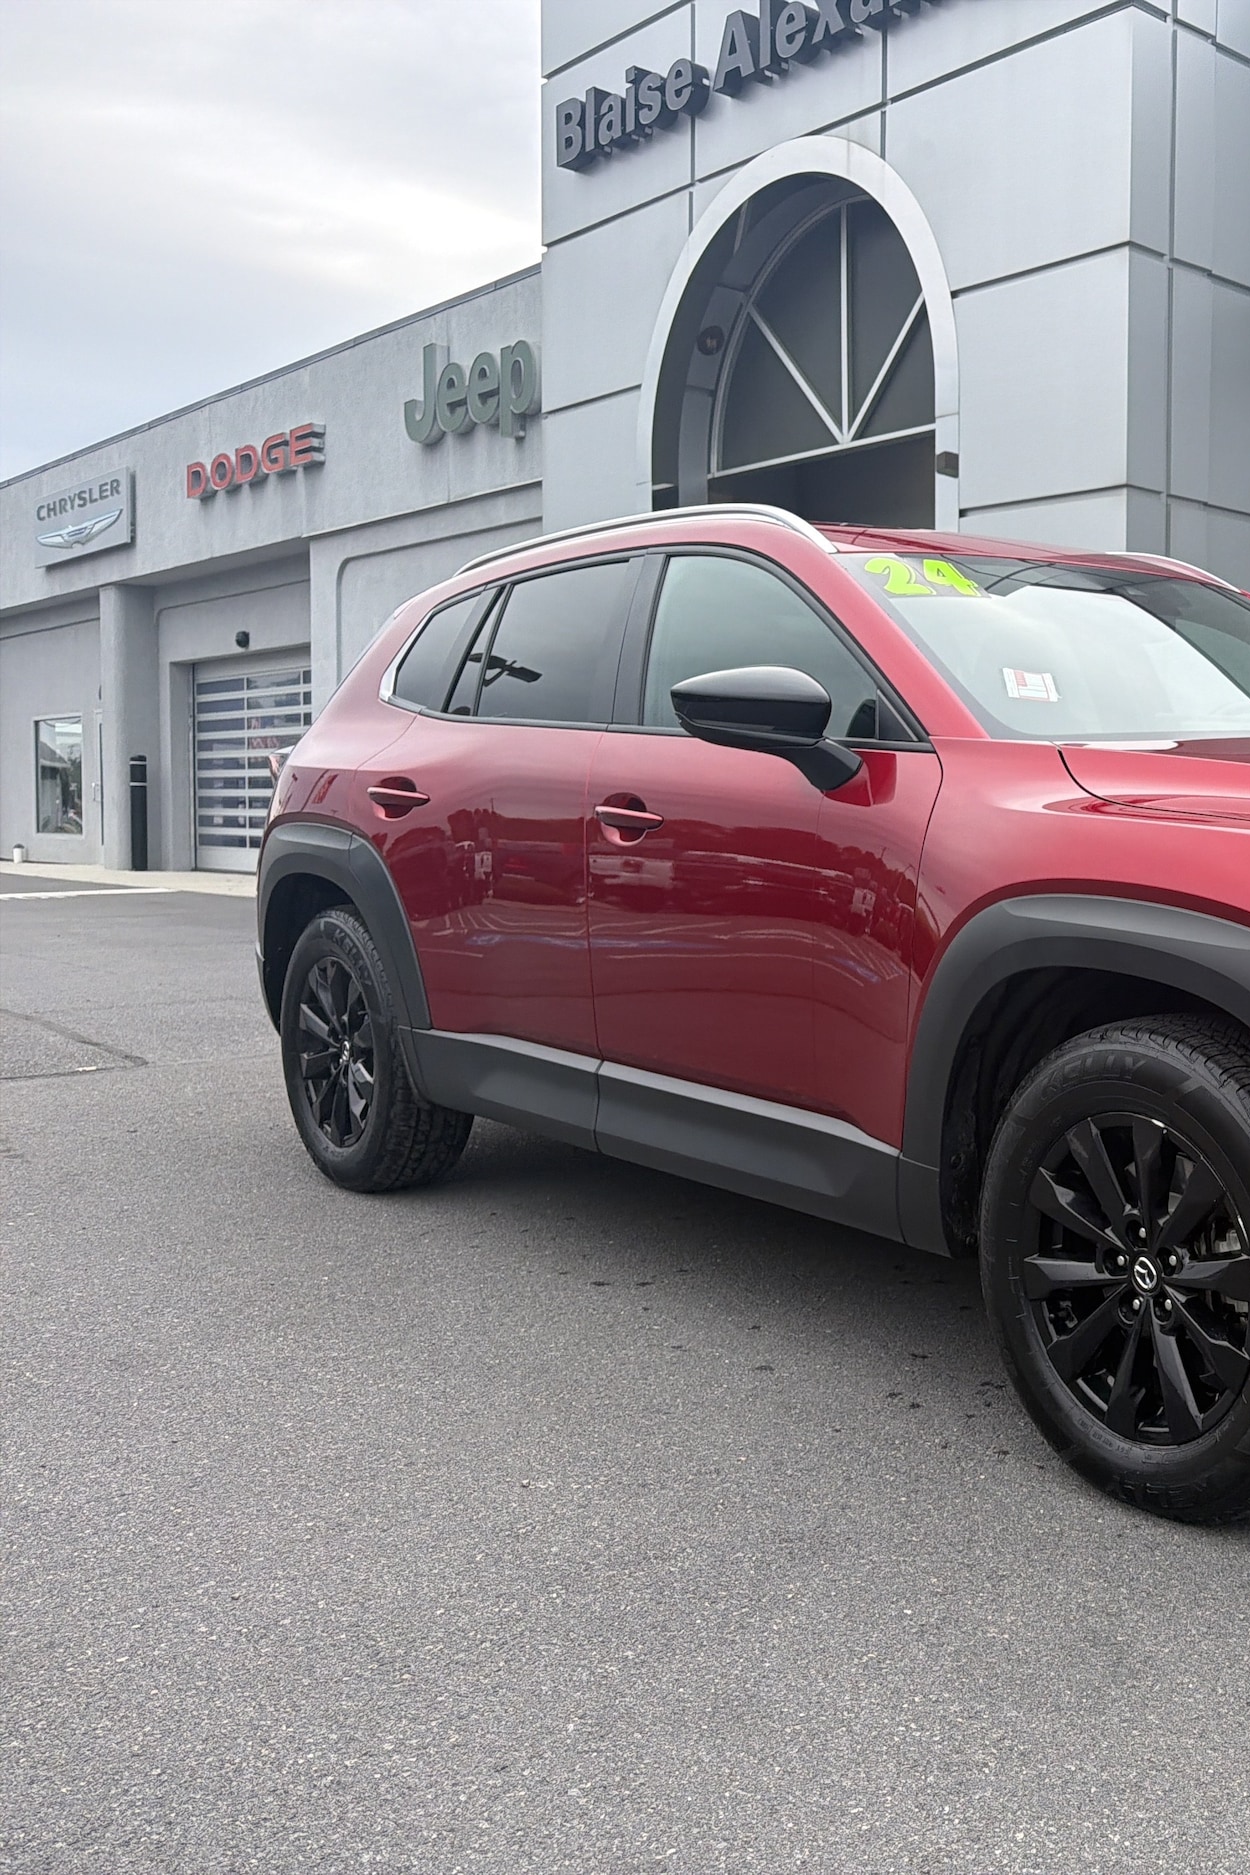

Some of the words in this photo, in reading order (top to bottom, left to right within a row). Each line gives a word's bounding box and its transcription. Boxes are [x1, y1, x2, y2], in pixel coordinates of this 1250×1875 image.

[556, 56, 697, 168] Blaise
[404, 339, 538, 443] Jeep
[186, 422, 320, 498] DODGE
[36, 478, 122, 522] CHRYSLER
[864, 556, 983, 597] 24
[1040, 1054, 1147, 1100] KELLY
